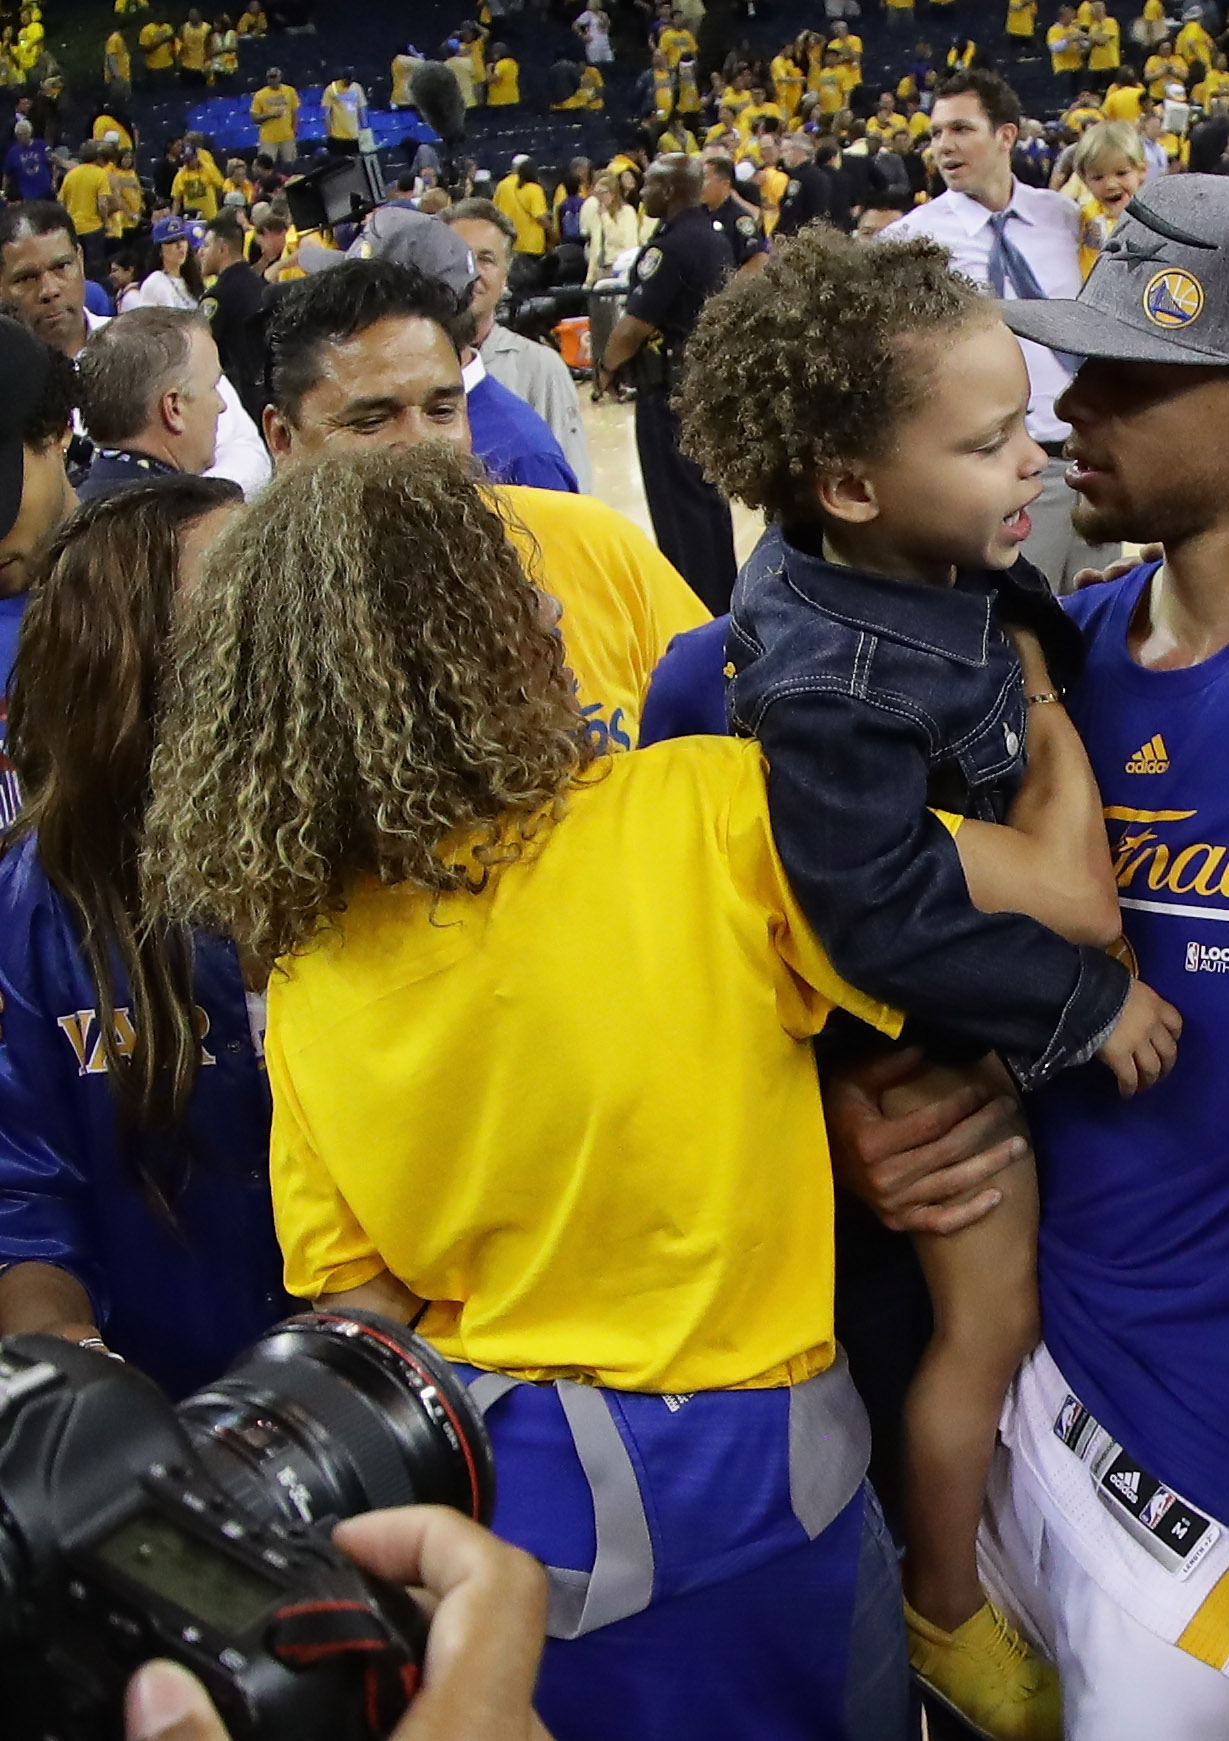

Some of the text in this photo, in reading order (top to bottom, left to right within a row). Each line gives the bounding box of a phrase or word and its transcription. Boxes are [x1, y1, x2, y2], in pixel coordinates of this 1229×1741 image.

[1125, 759, 1170, 774] adida
[1110, 1473, 1139, 1504] adidas
[1171, 1521, 1188, 1540] M
